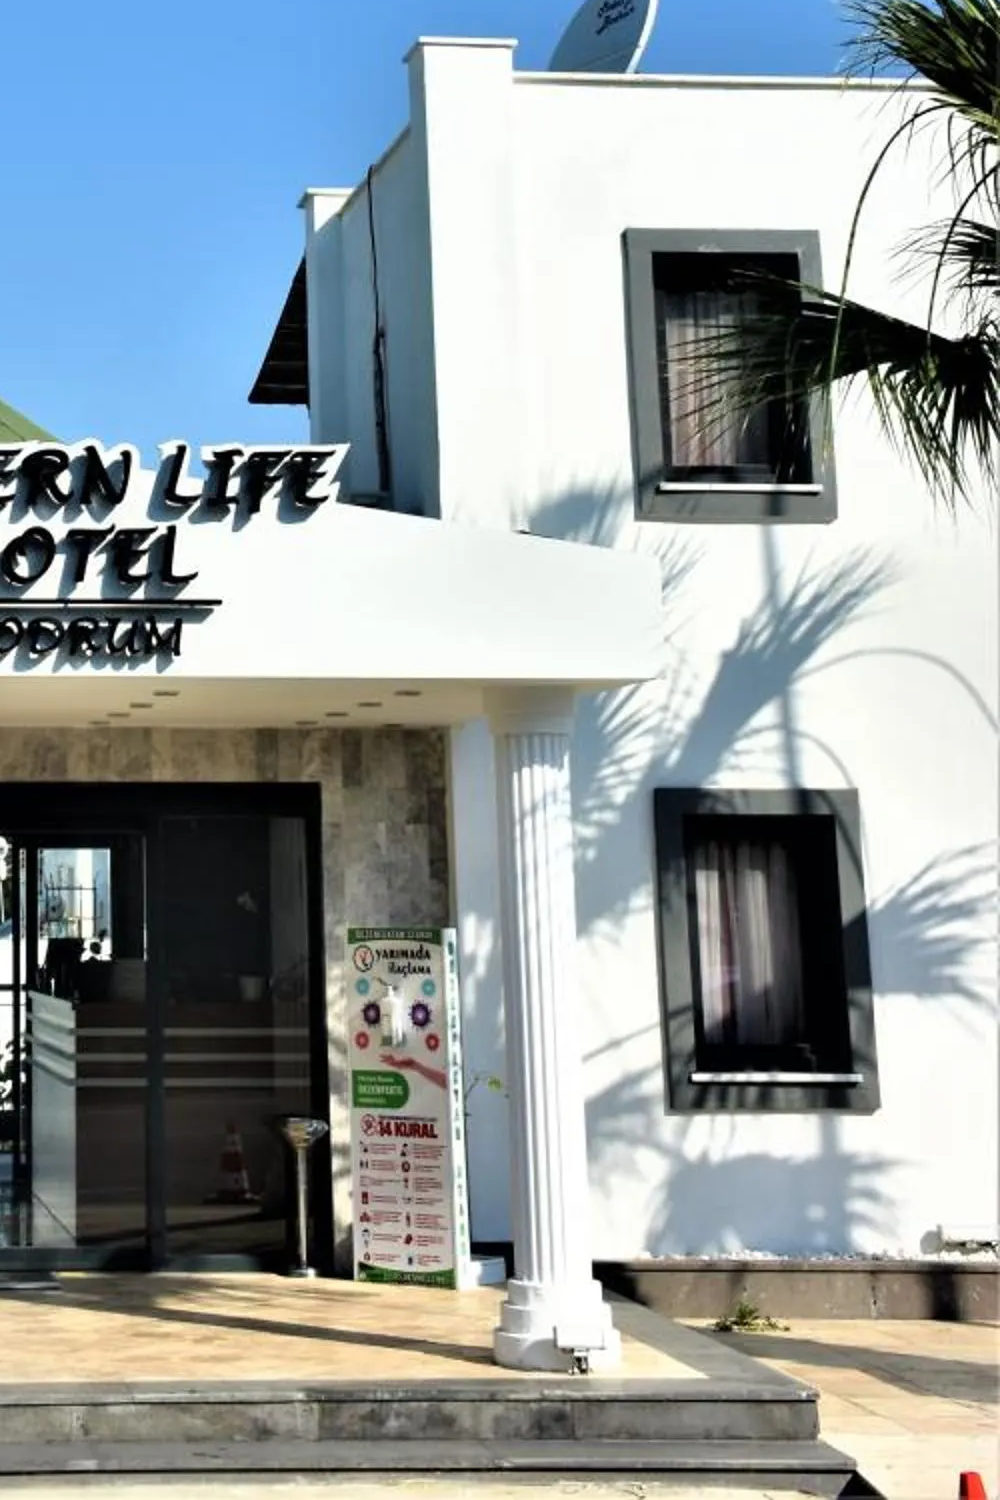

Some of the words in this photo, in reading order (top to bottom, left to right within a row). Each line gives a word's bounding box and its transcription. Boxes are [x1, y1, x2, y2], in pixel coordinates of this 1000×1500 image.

[163, 444, 339, 514] LIFE
[378, 1121, 392, 1137] 14
[394, 1121, 439, 1139] KURAL
